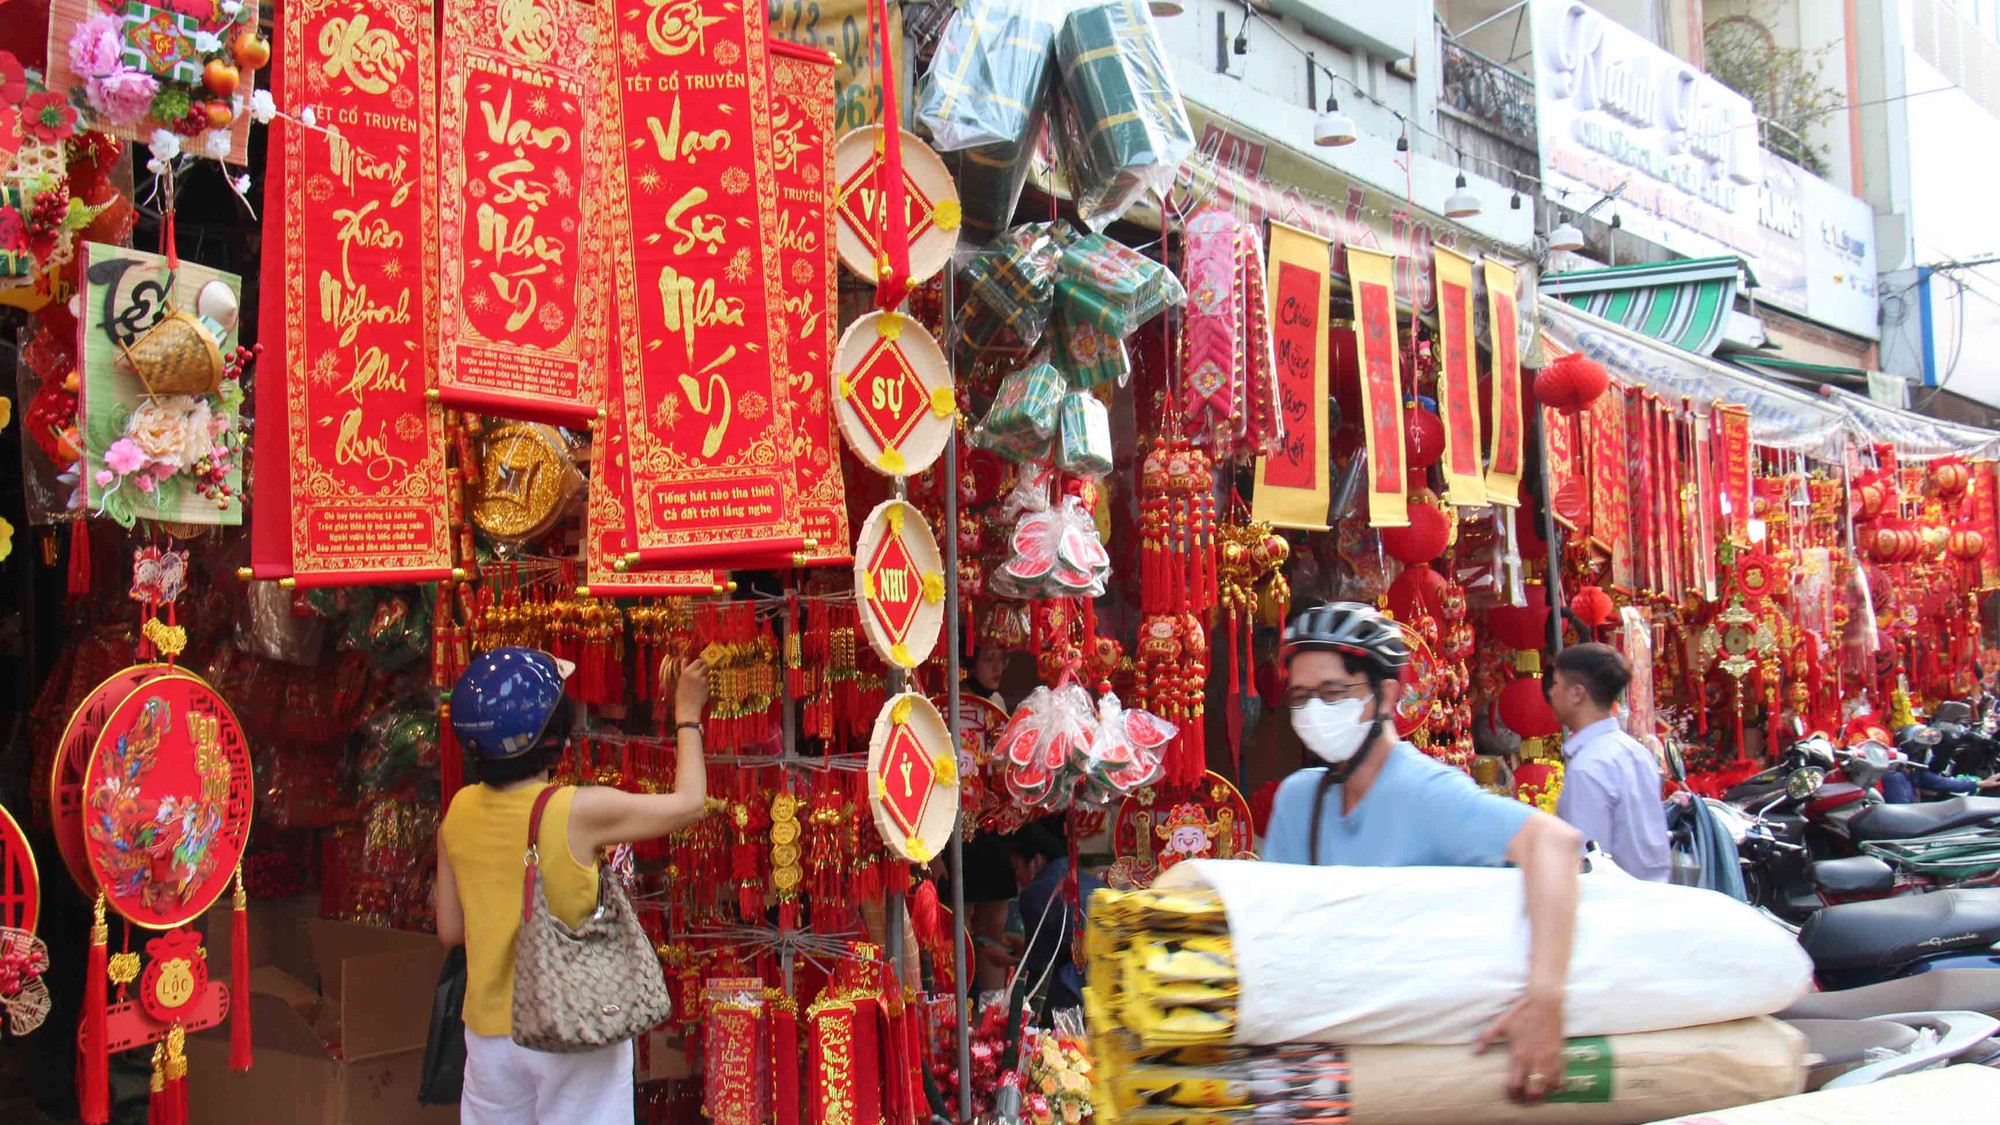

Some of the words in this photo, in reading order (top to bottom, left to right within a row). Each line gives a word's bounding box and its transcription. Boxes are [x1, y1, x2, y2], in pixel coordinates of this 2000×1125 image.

[466, 55, 508, 77] XUÂN
[512, 67, 554, 88] PHÁT
[625, 72, 652, 92] TẾT
[658, 70, 679, 91] CỔ
[480, 87, 571, 158] Vạn
[646, 92, 731, 164] Vạn
[488, 159, 551, 212] Sự
[477, 203, 565, 266] Như
[665, 187, 727, 255] Sự
[777, 209, 819, 252] húc
[332, 200, 403, 290] Xuân
[489, 264, 547, 332] Ý
[658, 265, 745, 370] Như
[335, 344, 408, 404] Phú
[871, 373, 905, 420] SỰ
[678, 344, 737, 458] Ý
[335, 407, 408, 481] Quý
[657, 490, 687, 504] Tiếng
[690, 490, 707, 502] hát
[710, 488, 729, 500] nào
[732, 487, 748, 499] tha
[751, 483, 775, 498] thiết
[664, 508, 678, 521] Cả
[681, 506, 698, 520] đất
[748, 503, 772, 517] nghe
[880, 565, 909, 602] NHƯ
[186, 710, 218, 744] Vạn
[899, 752, 913, 797] Ý
[1921, 931, 1978, 947] Grande
[162, 974, 188, 1000] LỘC
[820, 1032, 845, 1048] Chúc
